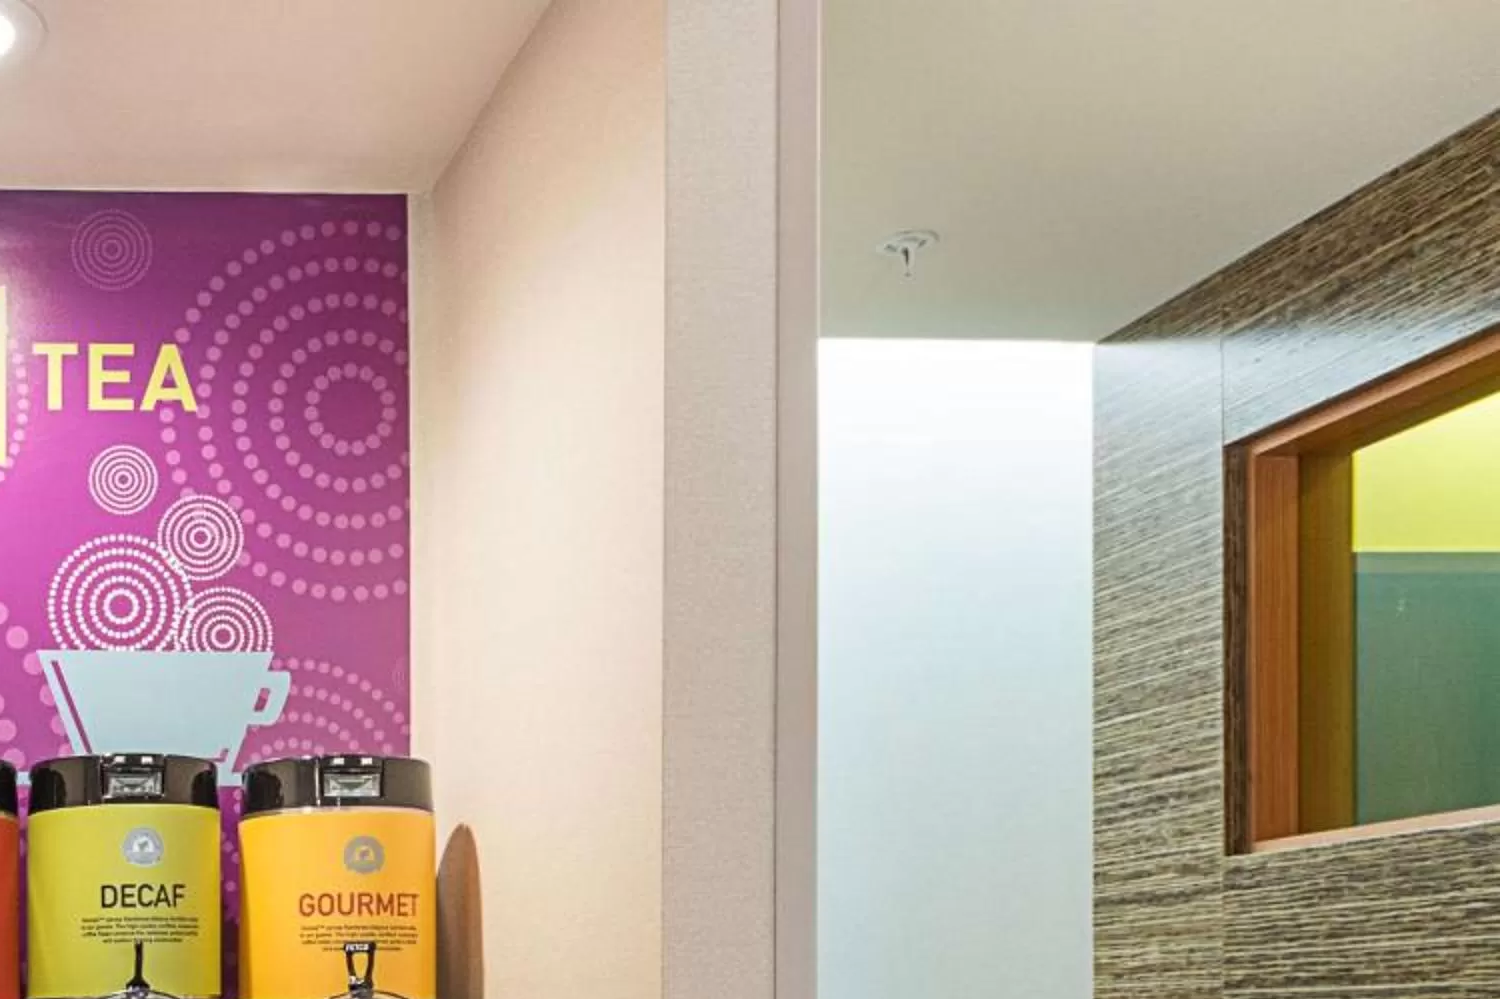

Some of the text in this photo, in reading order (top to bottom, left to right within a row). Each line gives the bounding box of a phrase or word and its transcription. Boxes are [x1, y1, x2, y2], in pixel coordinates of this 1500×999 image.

[32, 343, 197, 412] TEA
[100, 883, 186, 909] DECAF
[299, 892, 419, 917] GOURMET
